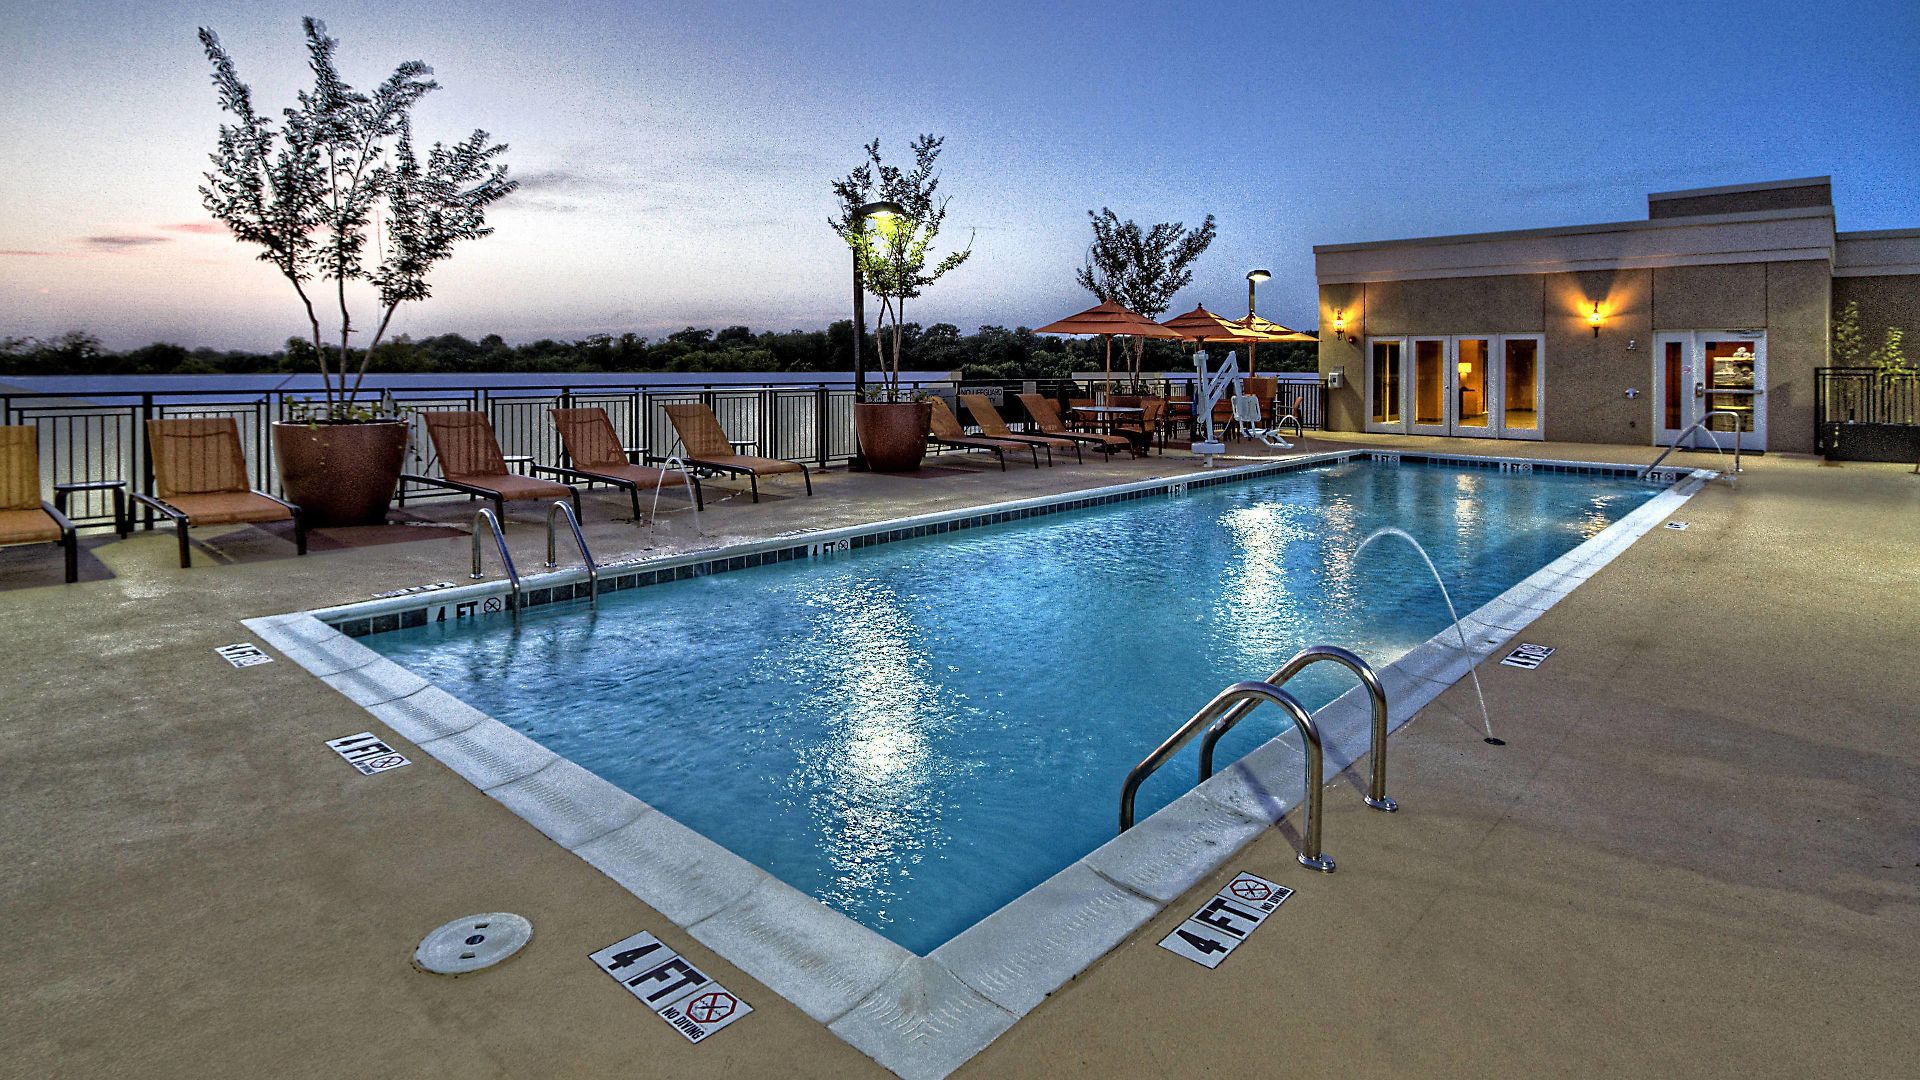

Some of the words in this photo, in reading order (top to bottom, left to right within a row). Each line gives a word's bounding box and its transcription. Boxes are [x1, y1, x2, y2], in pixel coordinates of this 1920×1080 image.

[822, 541, 836, 555] FT
[436, 606, 448, 623] 4
[456, 600, 479, 619] FT
[1510, 650, 1545, 662] FT
[333, 736, 374, 748] 4
[341, 742, 392, 760] FT
[1195, 897, 1261, 937] FT
[1175, 929, 1229, 955] 4
[607, 942, 663, 971] 4
[627, 958, 708, 1003] FT
[661, 1006, 680, 1020] NO
[672, 1015, 705, 1040] DIVING
